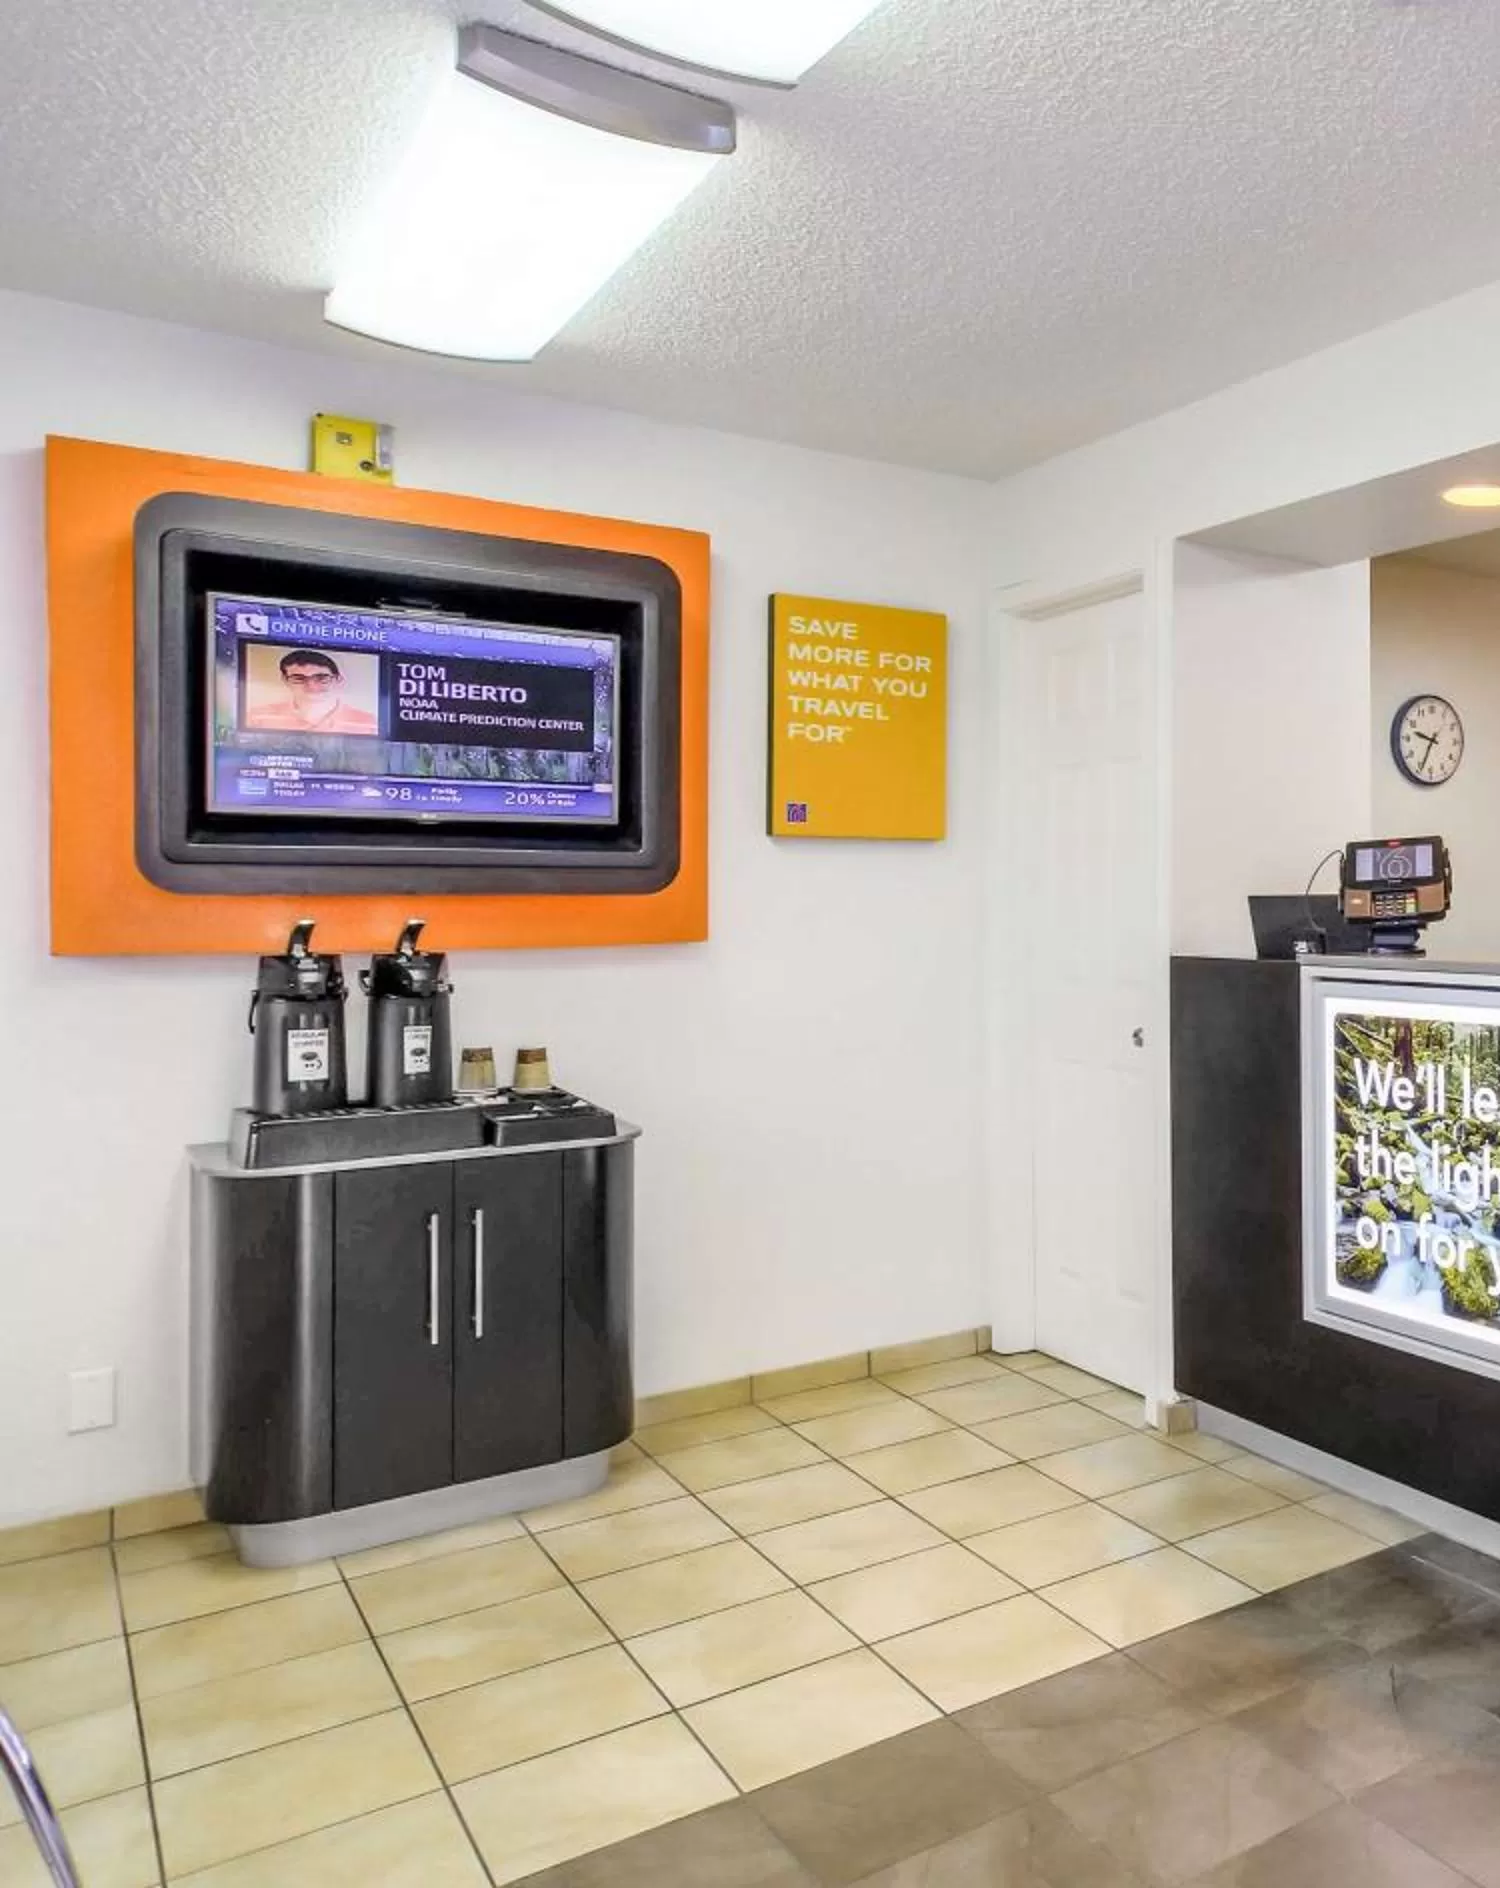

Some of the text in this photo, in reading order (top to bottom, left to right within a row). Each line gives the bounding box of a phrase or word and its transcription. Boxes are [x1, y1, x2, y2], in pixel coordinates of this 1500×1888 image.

[271, 621, 389, 643] ON THE PHONE
[788, 615, 859, 641] SAVE
[788, 643, 932, 673] MORE FOR
[396, 663, 447, 681] TOM
[788, 669, 928, 699] WHAT YOU
[398, 679, 528, 704] DI LIBERTO
[398, 697, 439, 710] NOAA
[788, 694, 891, 721] TRAVEL
[399, 709, 585, 732] CLIMATE PREDICTION CENTER
[385, 787, 413, 801] 98
[504, 791, 545, 806] 20%
[1353, 1057, 1446, 1116] We'll
[1354, 1129, 1417, 1185] the
[1356, 1216, 1400, 1254] on
[1416, 1212, 1474, 1273] for
